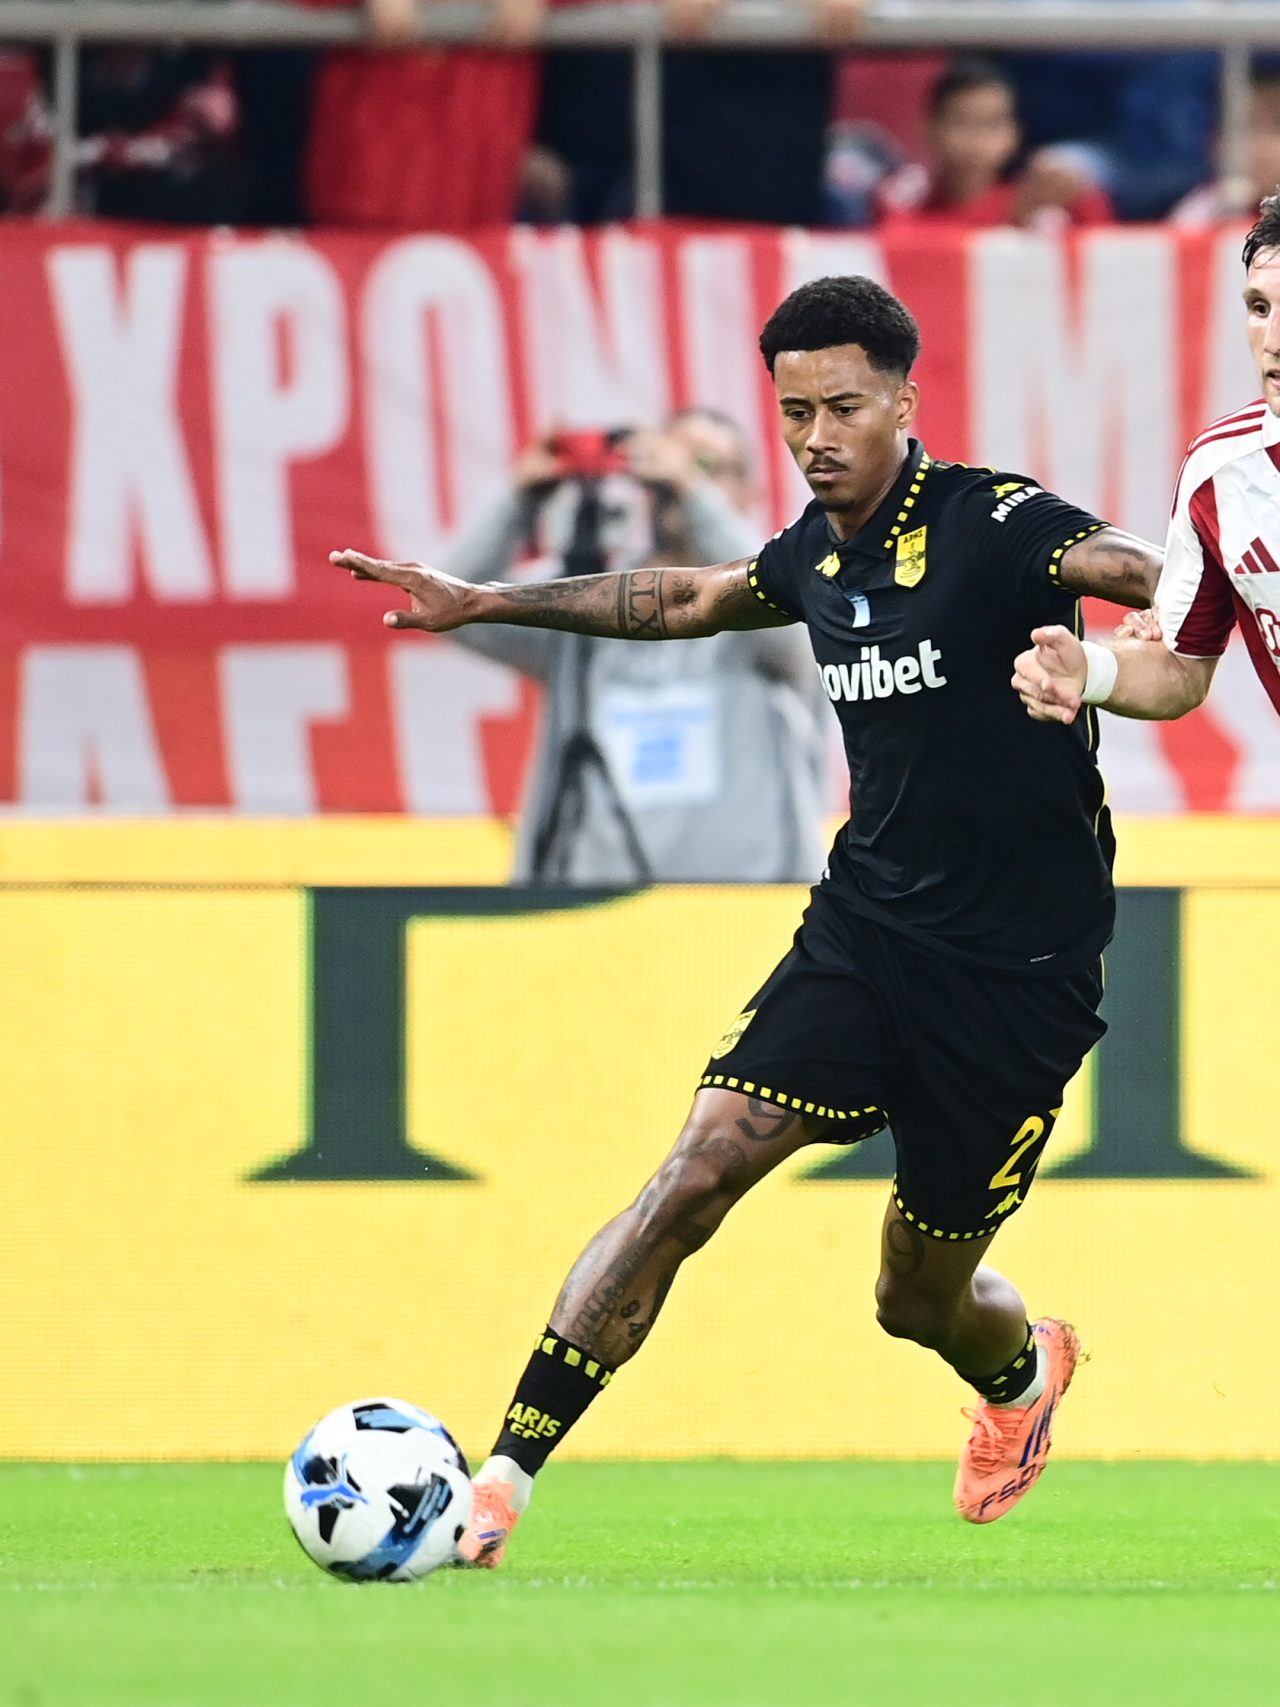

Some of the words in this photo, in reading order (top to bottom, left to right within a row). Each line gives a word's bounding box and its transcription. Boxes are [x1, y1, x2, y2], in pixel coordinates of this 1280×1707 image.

[45, 232, 895, 604] ΧΡΟΝΙ
[988, 1106, 1062, 1190] 2
[507, 1402, 562, 1437] ARIS
